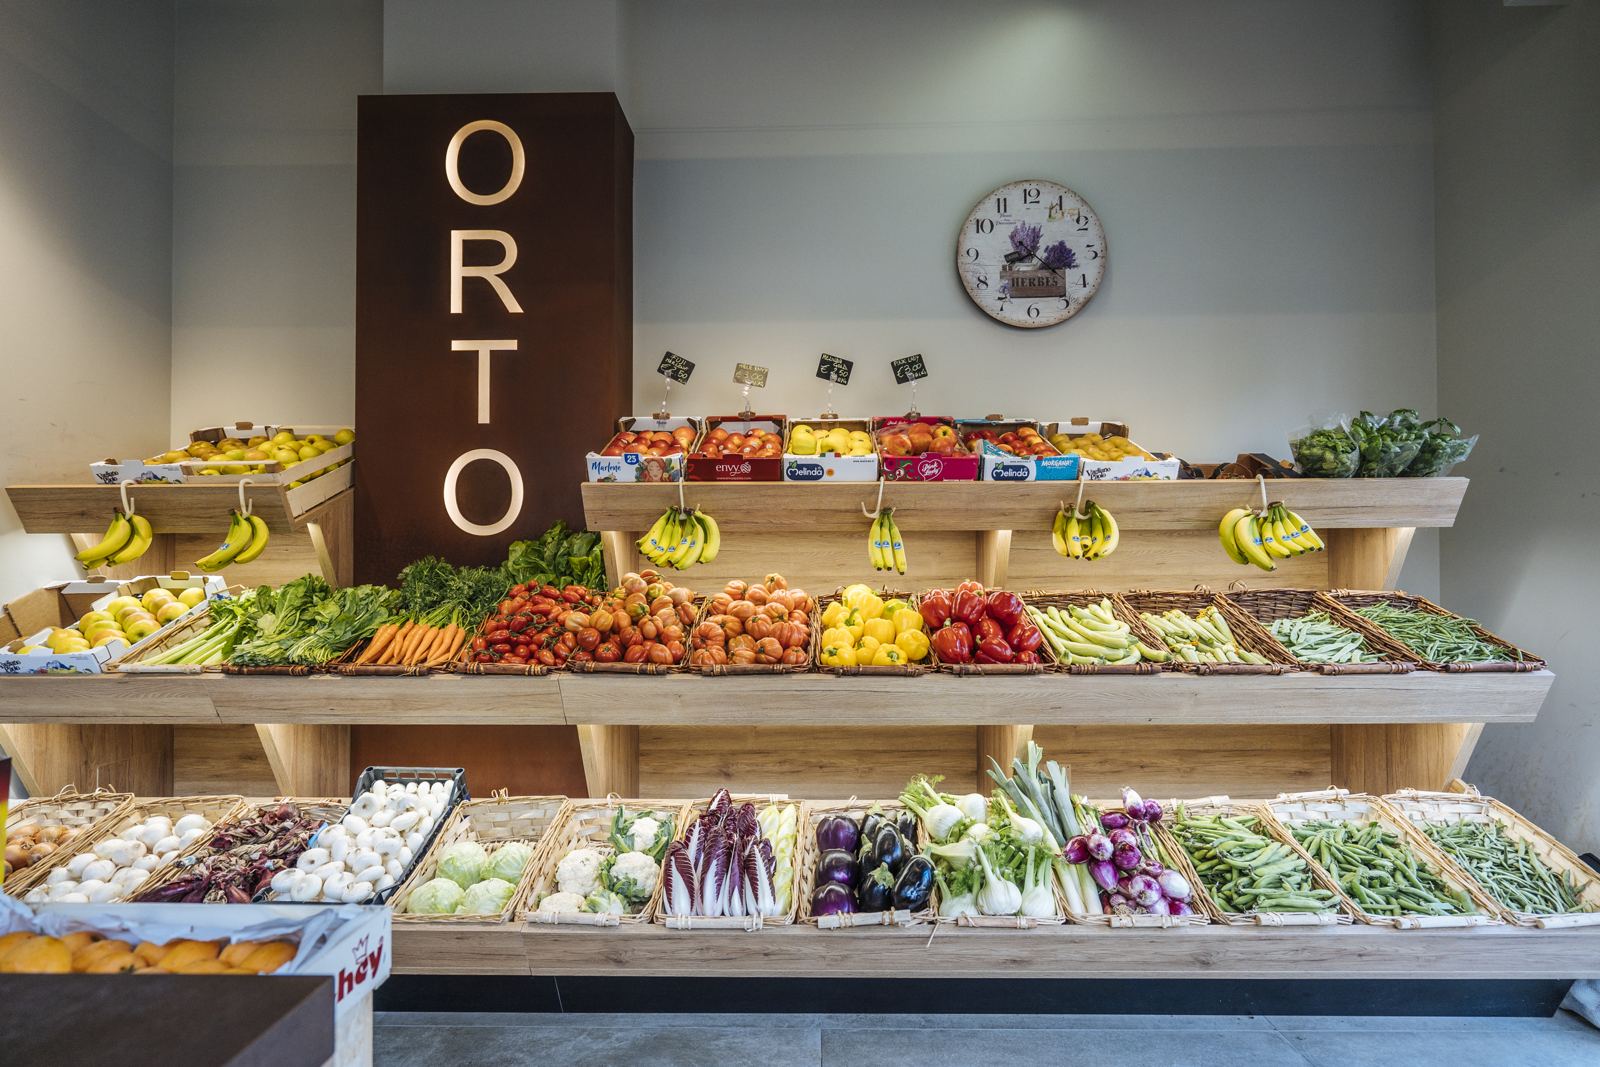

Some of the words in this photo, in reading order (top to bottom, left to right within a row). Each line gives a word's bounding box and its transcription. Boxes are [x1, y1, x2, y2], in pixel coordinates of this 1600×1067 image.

[1023, 188, 1041, 205] 12
[997, 197, 1008, 213] 11
[976, 218, 994, 234] 10
[1076, 215, 1089, 231] 2
[966, 247, 980, 263] 9
[1086, 244, 1098, 260] 3
[976, 275, 989, 290] 8
[1011, 276, 1058, 287] HERBES
[1076, 273, 1089, 288] 4
[997, 296, 1008, 312] 7
[1027, 302, 1040, 318] 6
[444, 119, 526, 536] ORTO
[592, 461, 621, 475] Marlene
[788, 467, 823, 476] Melinda
[993, 467, 1028, 477] Melinda
